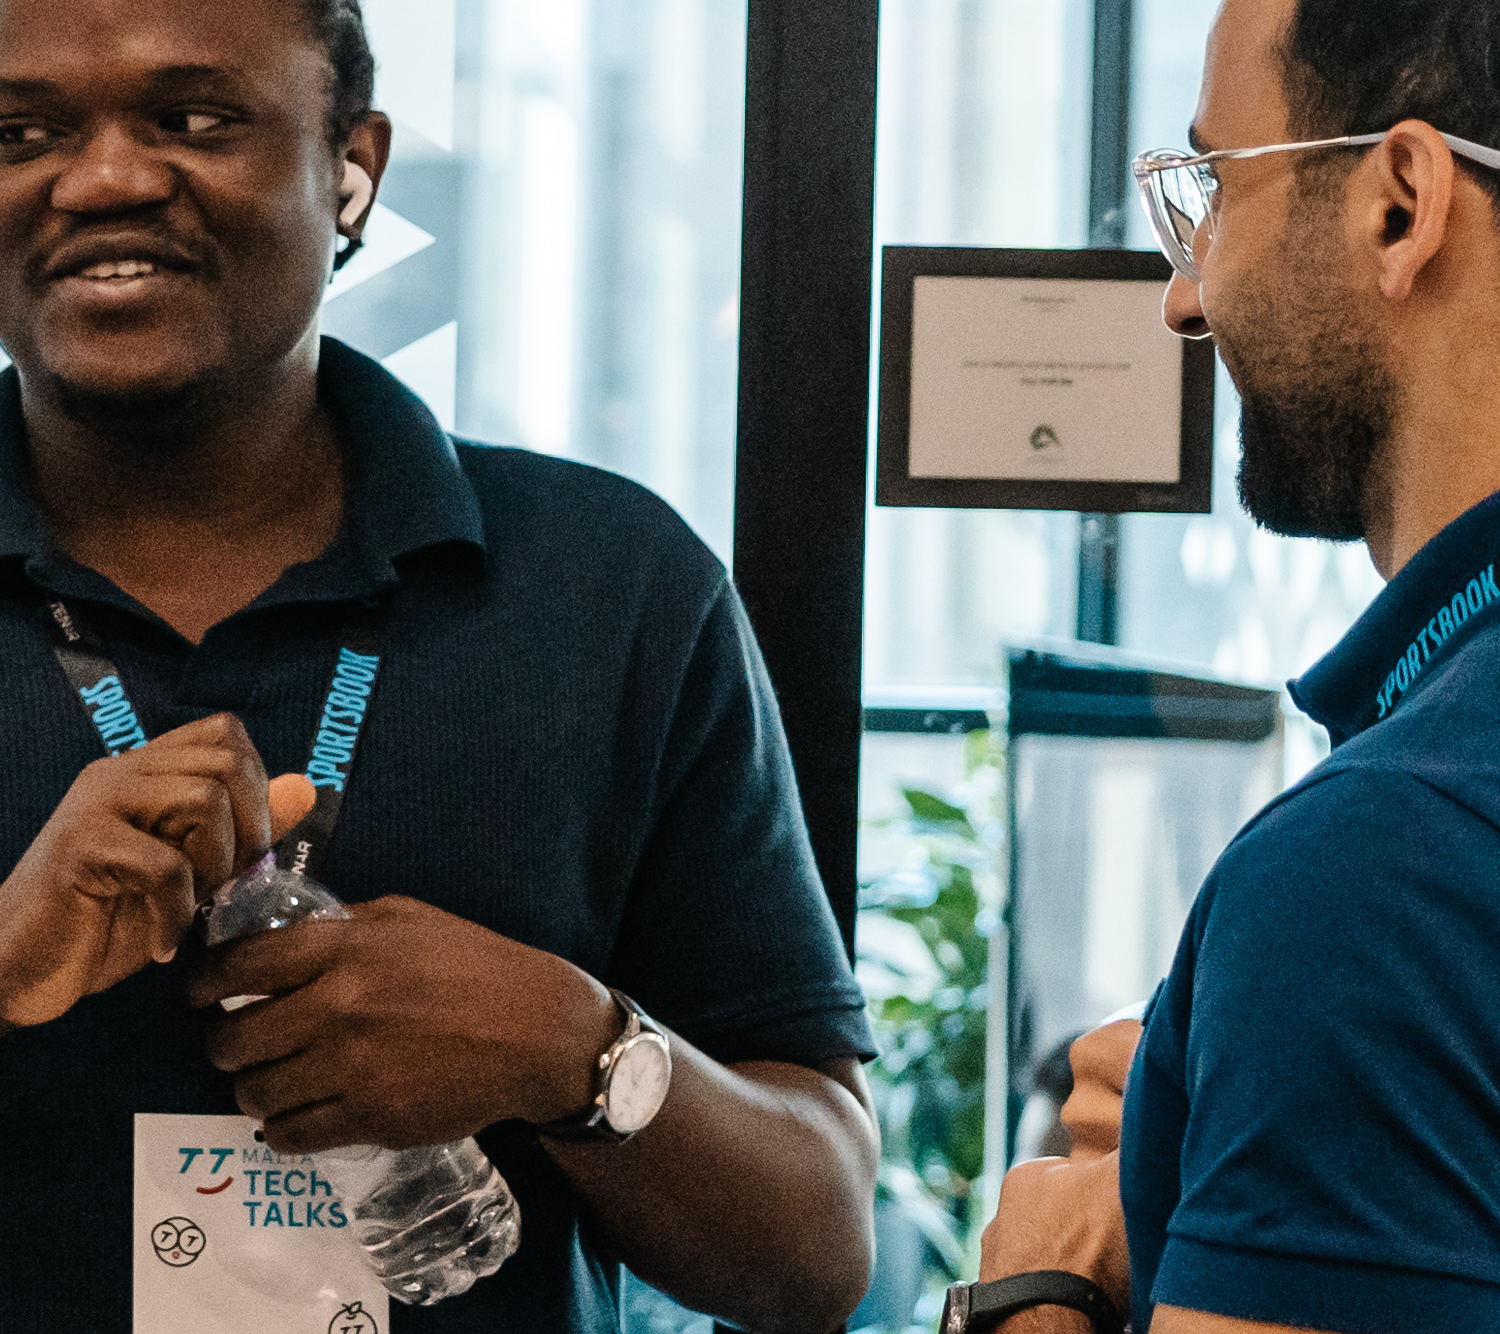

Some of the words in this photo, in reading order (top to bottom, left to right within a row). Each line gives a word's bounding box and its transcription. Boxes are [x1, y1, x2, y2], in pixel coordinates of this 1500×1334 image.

[1376, 563, 1500, 719] SPORTSBOOK
[79, 675, 148, 758] SPORT
[305, 647, 379, 793] SPORTSBOOK
[243, 1201, 348, 1228] TALKS
